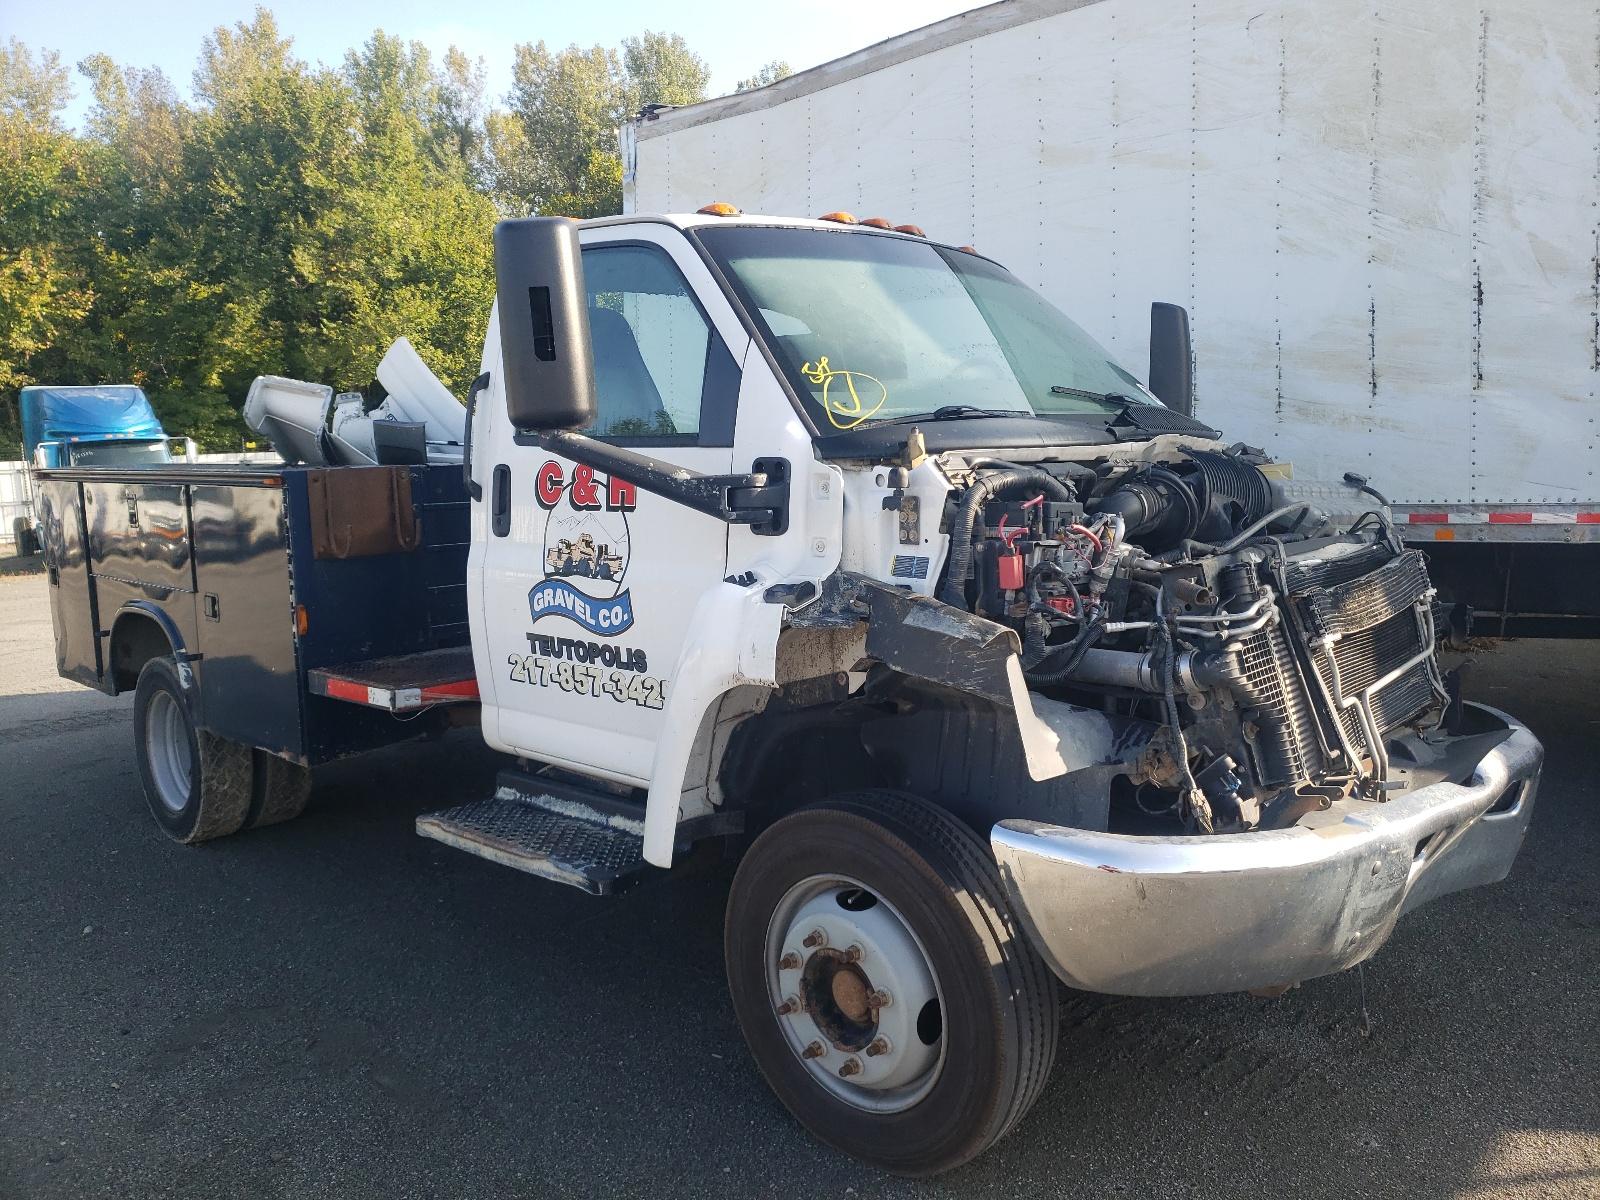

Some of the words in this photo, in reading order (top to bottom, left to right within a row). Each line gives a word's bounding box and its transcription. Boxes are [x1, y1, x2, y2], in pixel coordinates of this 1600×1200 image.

[535, 459, 564, 510] C
[569, 463, 602, 511] &
[533, 588, 596, 626] GRAVEL
[599, 605, 628, 628] CO.
[525, 632, 648, 674] TEUTOPOLIS
